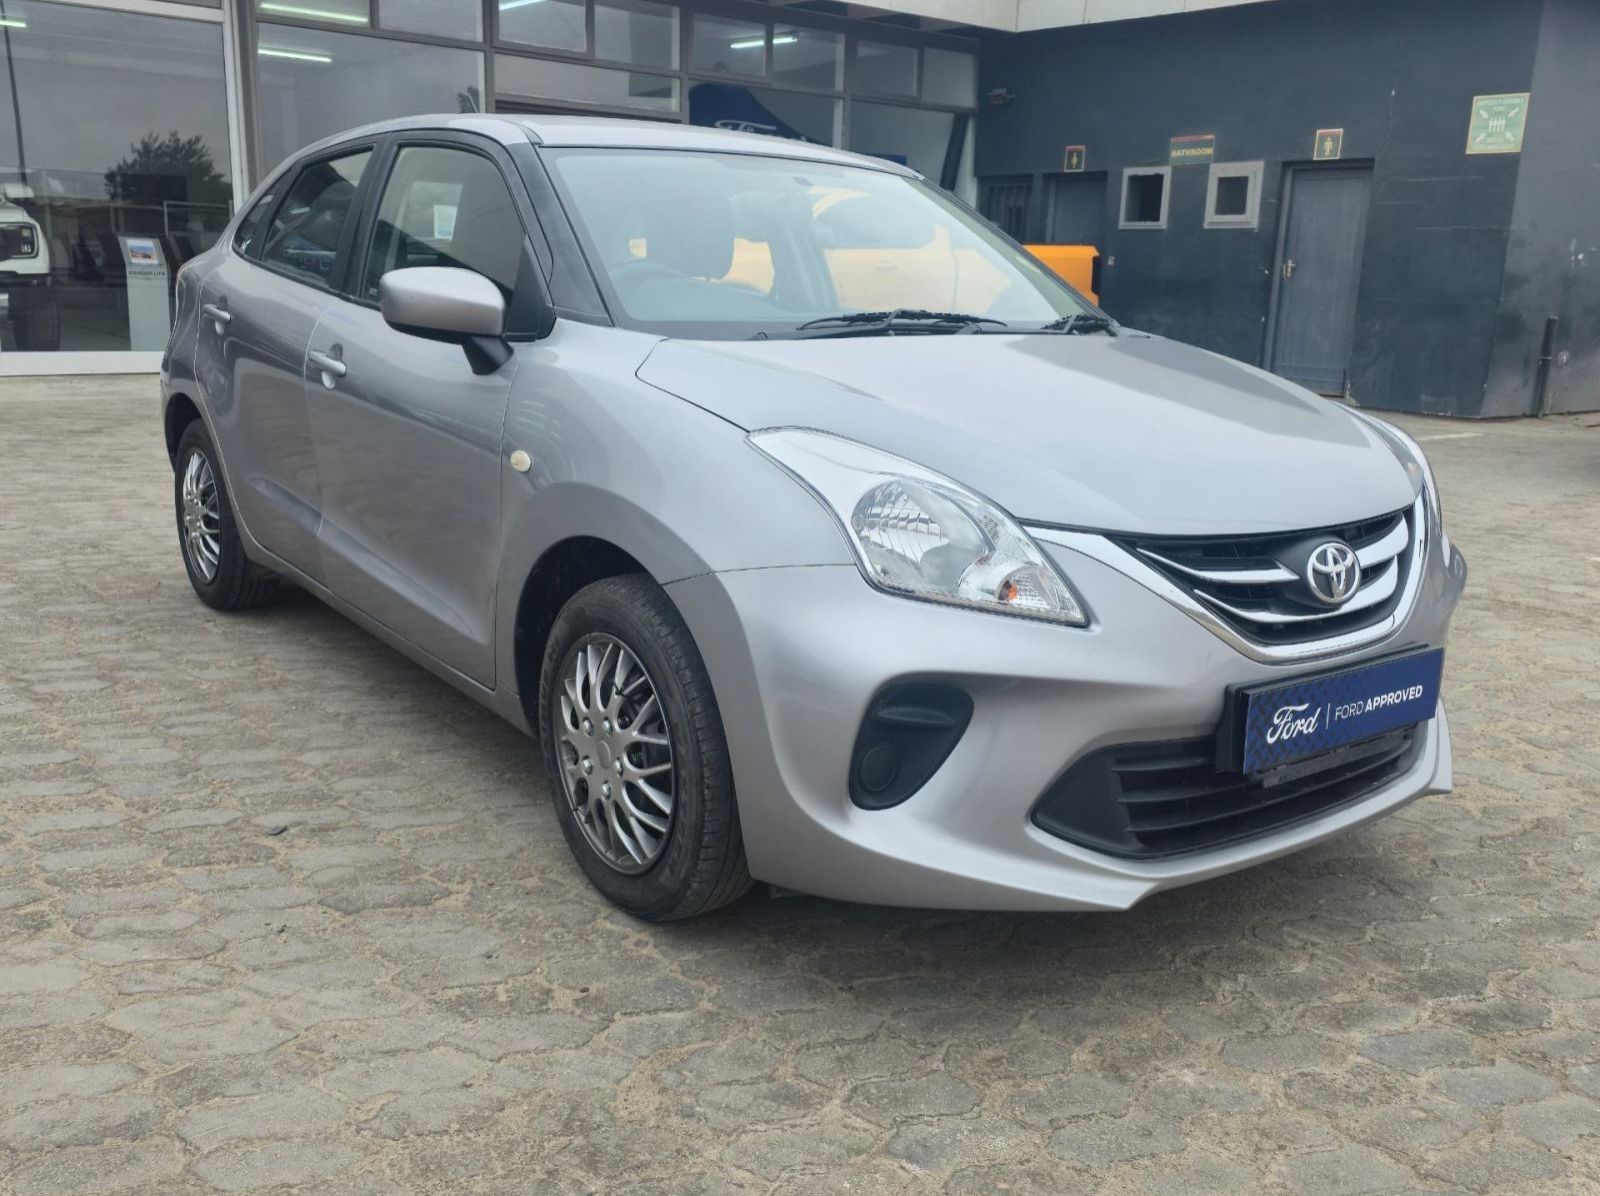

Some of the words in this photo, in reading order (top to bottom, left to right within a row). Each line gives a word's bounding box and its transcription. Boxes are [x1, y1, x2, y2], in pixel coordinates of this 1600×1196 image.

[1171, 147, 1213, 157] BATHROOM
[1266, 703, 1321, 744] Ford
[1335, 700, 1364, 721] FORD
[1364, 685, 1423, 712] APPROVED
